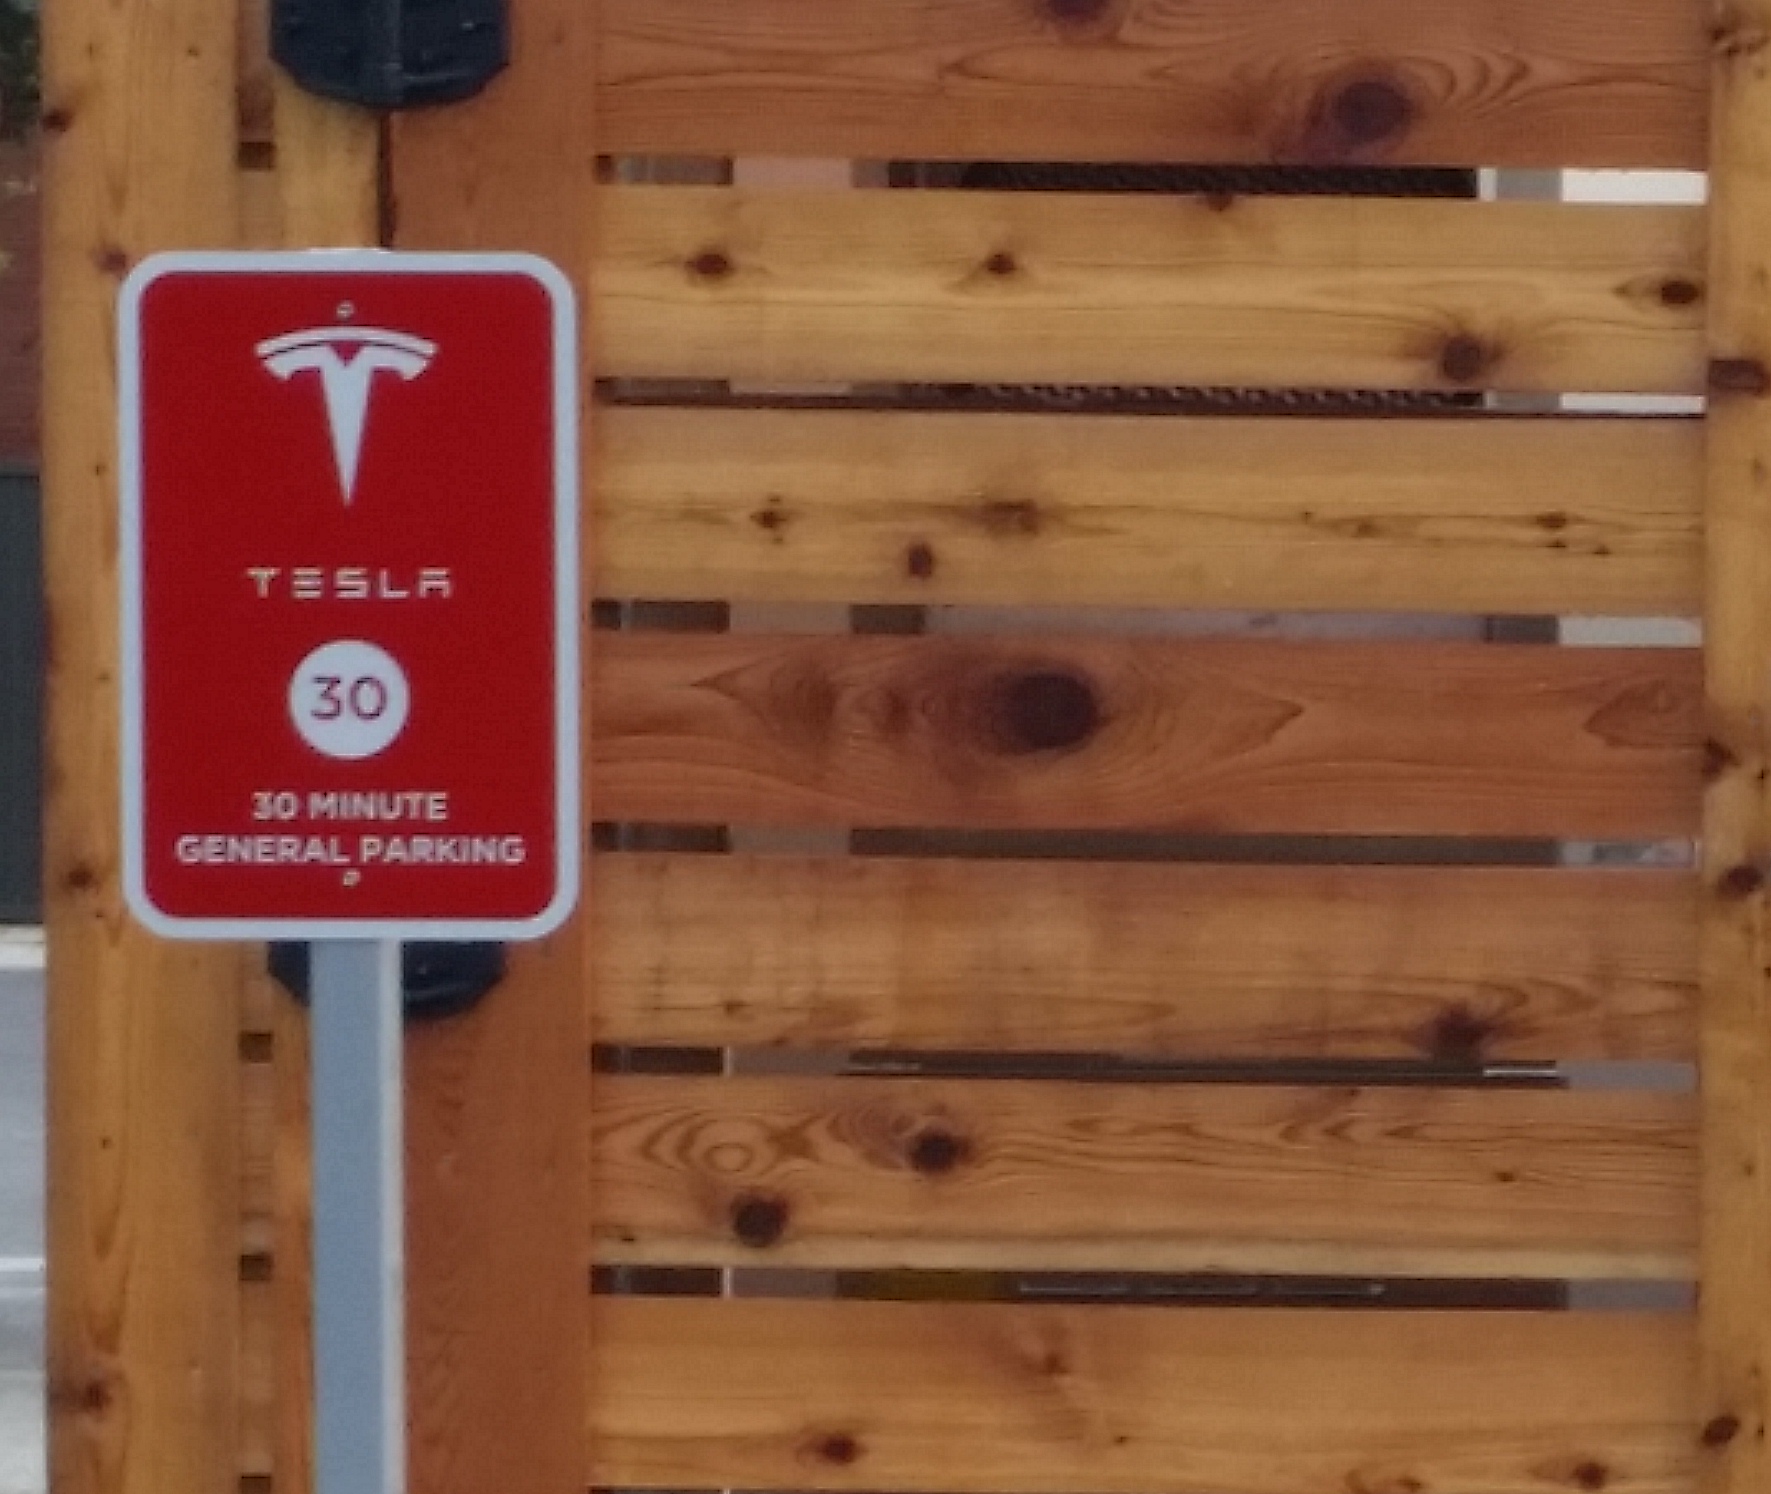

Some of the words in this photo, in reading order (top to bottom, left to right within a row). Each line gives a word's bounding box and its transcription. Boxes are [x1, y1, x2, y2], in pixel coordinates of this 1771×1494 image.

[246, 567, 451, 599] TESLA
[311, 676, 388, 721] 30
[252, 791, 300, 821] 30
[307, 791, 448, 822] MINUTE
[175, 834, 351, 864] GENERAL
[359, 835, 526, 865] PARKING
